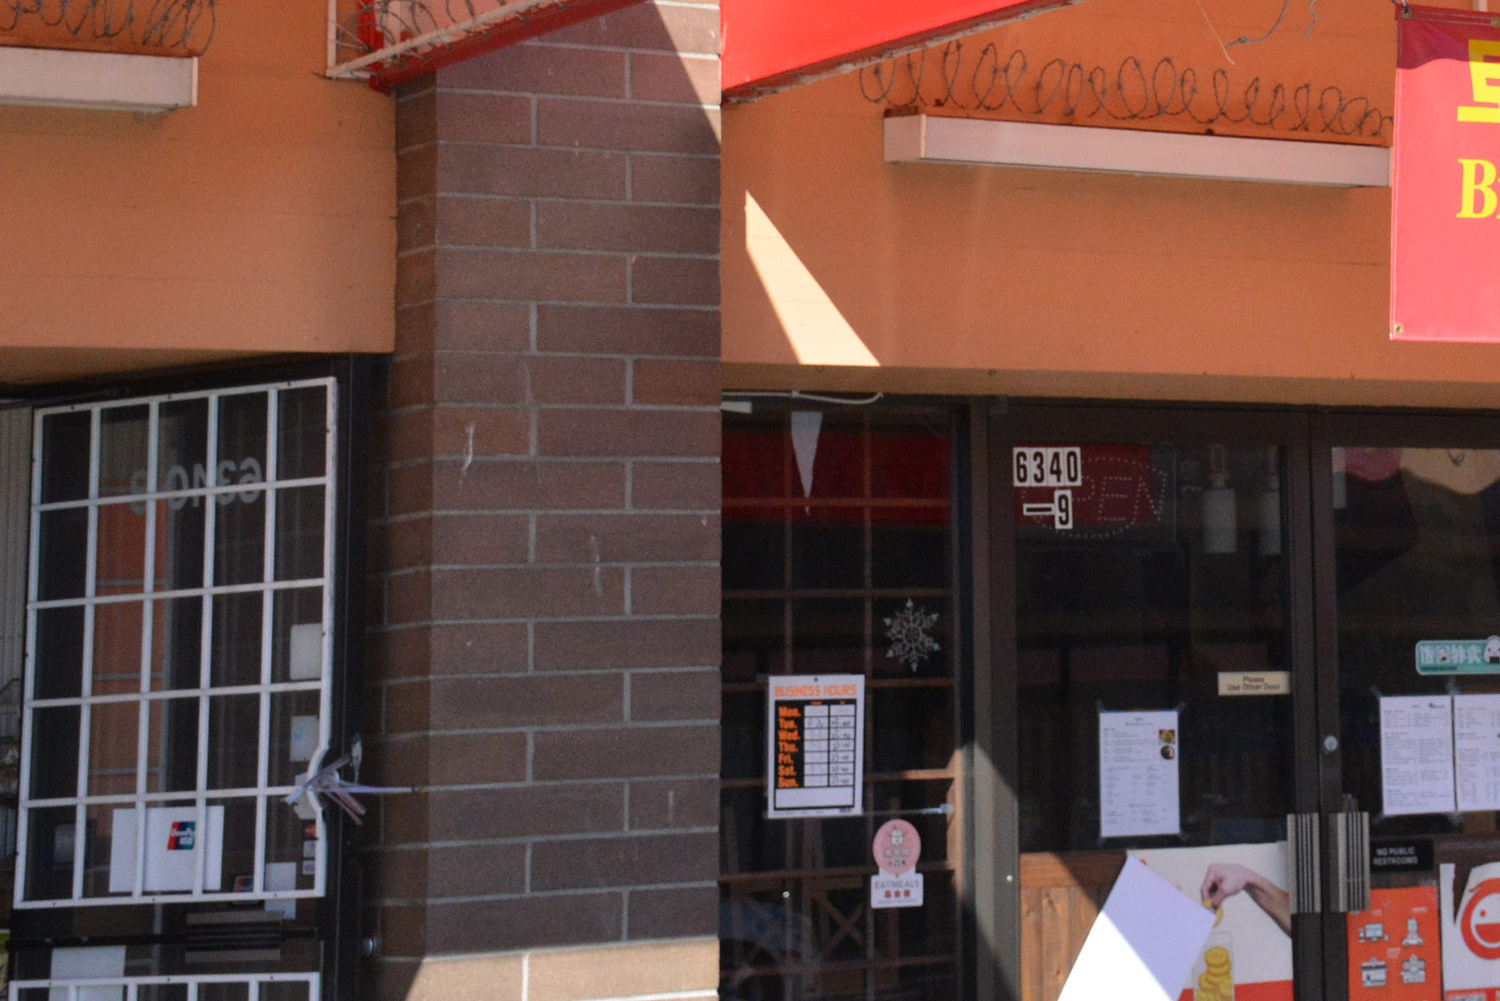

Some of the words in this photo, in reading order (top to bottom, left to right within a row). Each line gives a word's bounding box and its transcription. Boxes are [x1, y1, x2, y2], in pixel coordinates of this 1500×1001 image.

[1016, 451, 1079, 484] 6340
[775, 685, 822, 698] BUSINESS
[823, 684, 858, 696] HOURS
[1376, 848, 1388, 856] NO
[1389, 846, 1415, 855] PUBLIC
